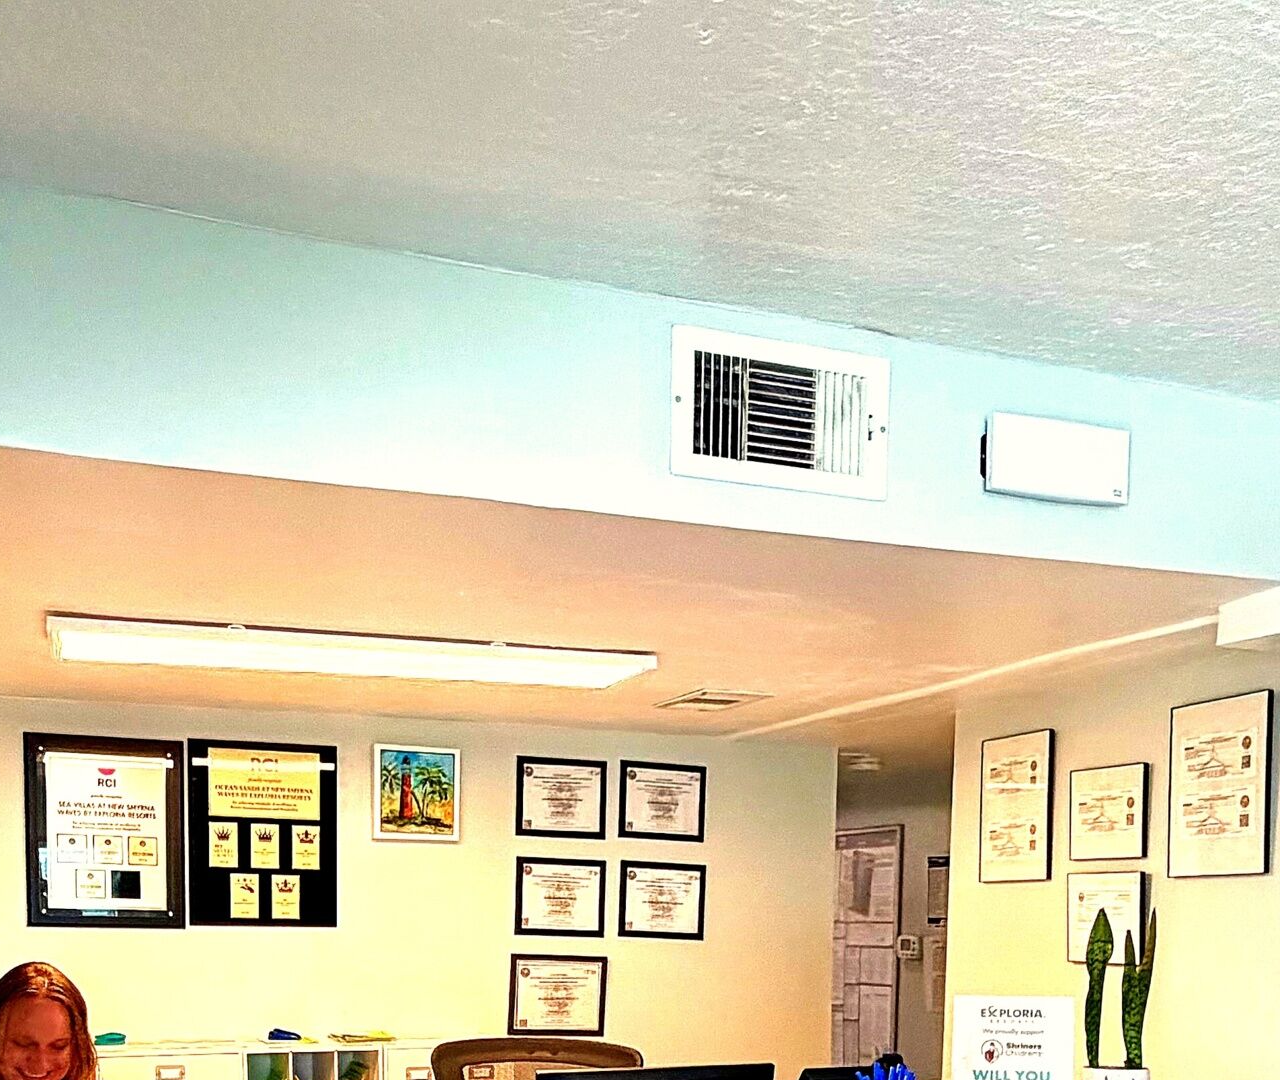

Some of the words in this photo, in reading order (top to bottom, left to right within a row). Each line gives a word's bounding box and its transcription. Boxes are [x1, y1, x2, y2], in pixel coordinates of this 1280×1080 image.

[97, 778, 116, 788] RCI
[980, 1005, 1043, 1018] EXPLORIA
[973, 1069, 1010, 1080] WILL
